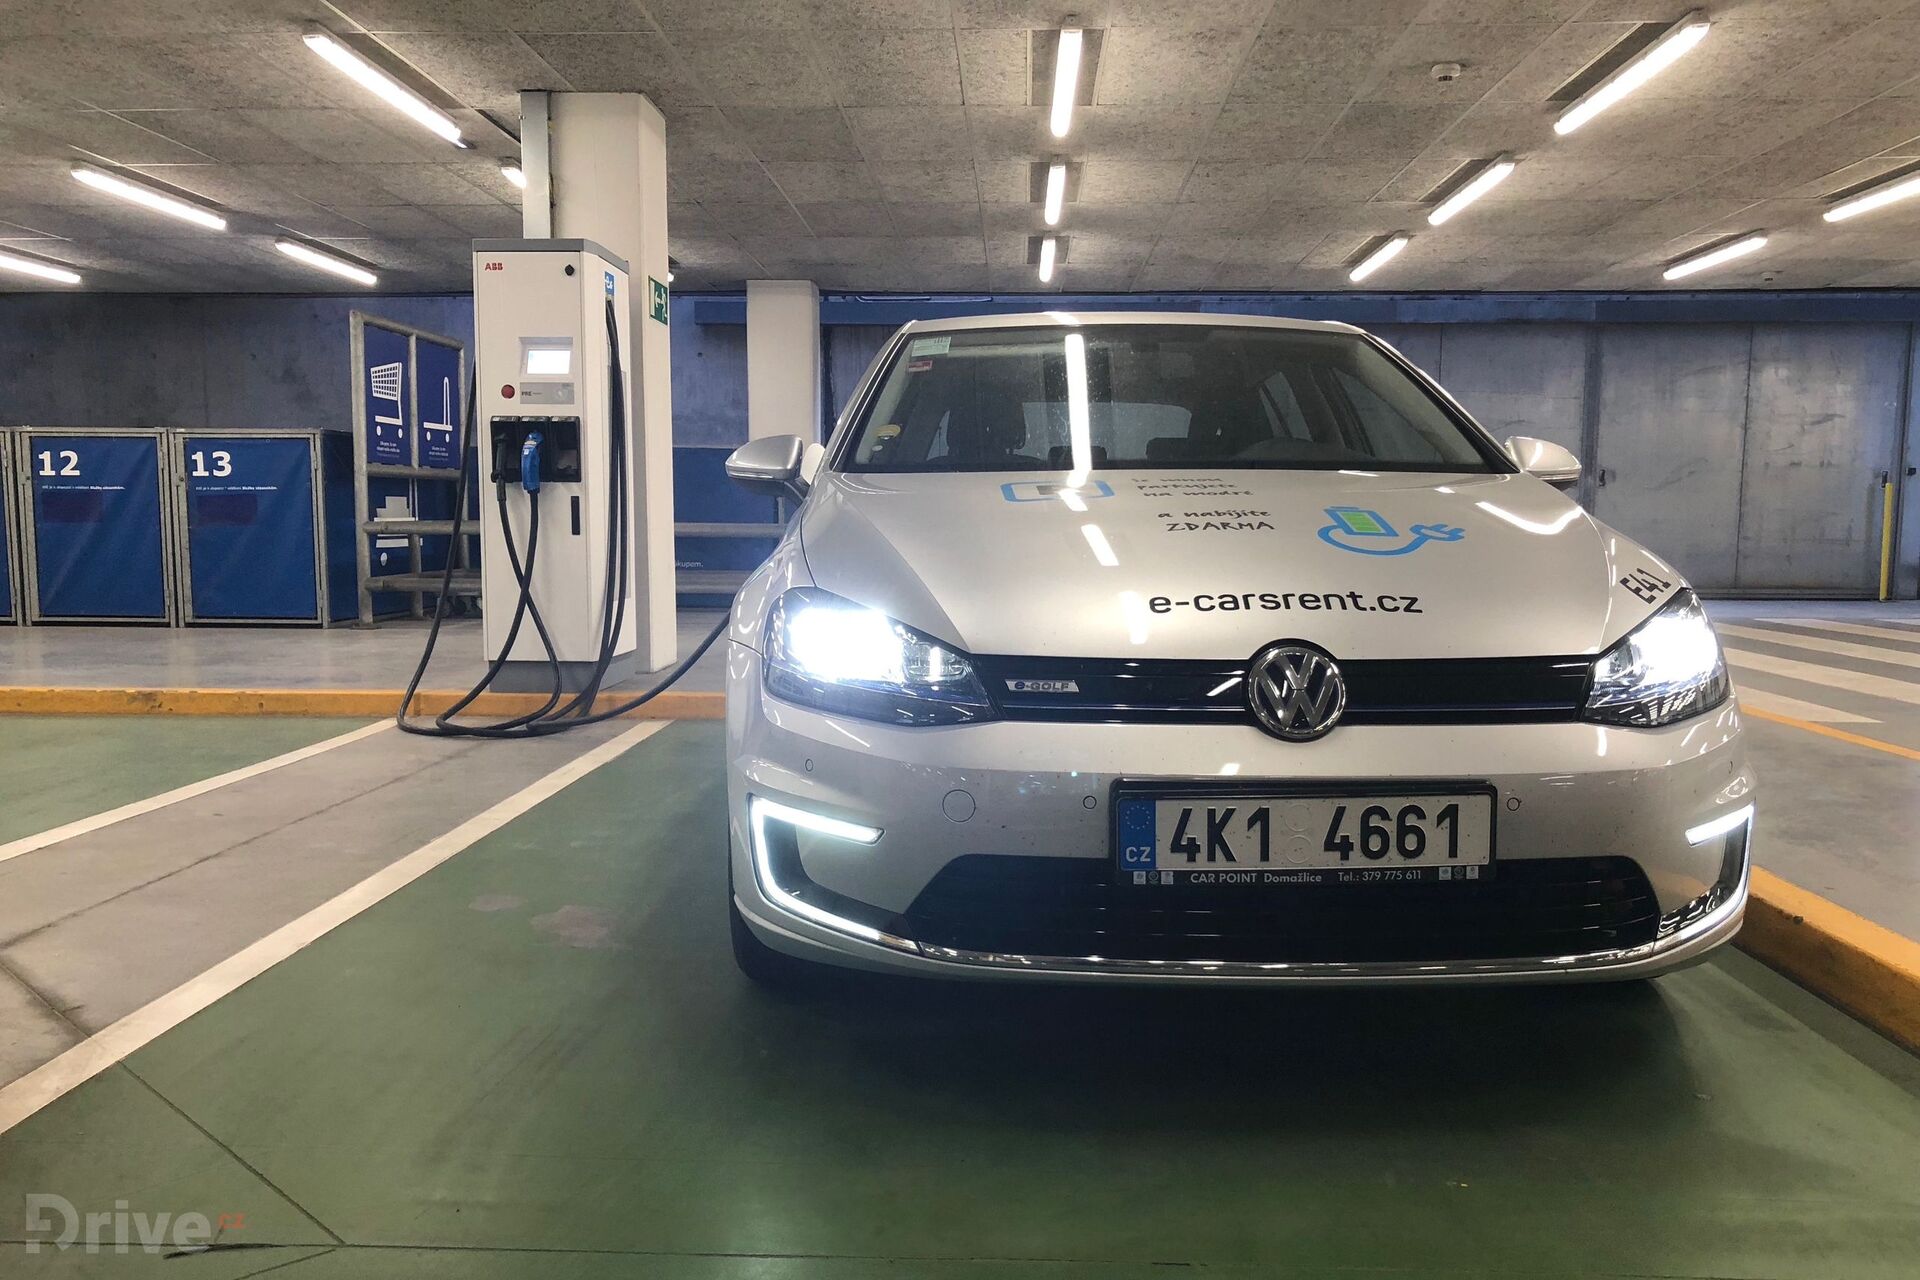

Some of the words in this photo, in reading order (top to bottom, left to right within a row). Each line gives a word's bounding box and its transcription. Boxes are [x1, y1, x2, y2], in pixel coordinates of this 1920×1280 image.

[38, 451, 80, 476] 12
[191, 451, 232, 477] 13
[1166, 521, 1275, 531] ZDARMA
[1619, 567, 1671, 604] E41
[1149, 591, 1423, 613] e-carsrent.cz
[1170, 807, 1270, 862] 4K1
[1324, 803, 1460, 861] 4661
[1125, 847, 1151, 862] CZ
[1190, 873, 1215, 883] CAR
[1219, 872, 1257, 883] POINT
[1264, 872, 1322, 883] Domažlice
[1338, 871, 1359, 882] Tel.:
[1362, 870, 1381, 881] 379
[1384, 870, 1402, 880] 775
[1406, 869, 1421, 880] 611
